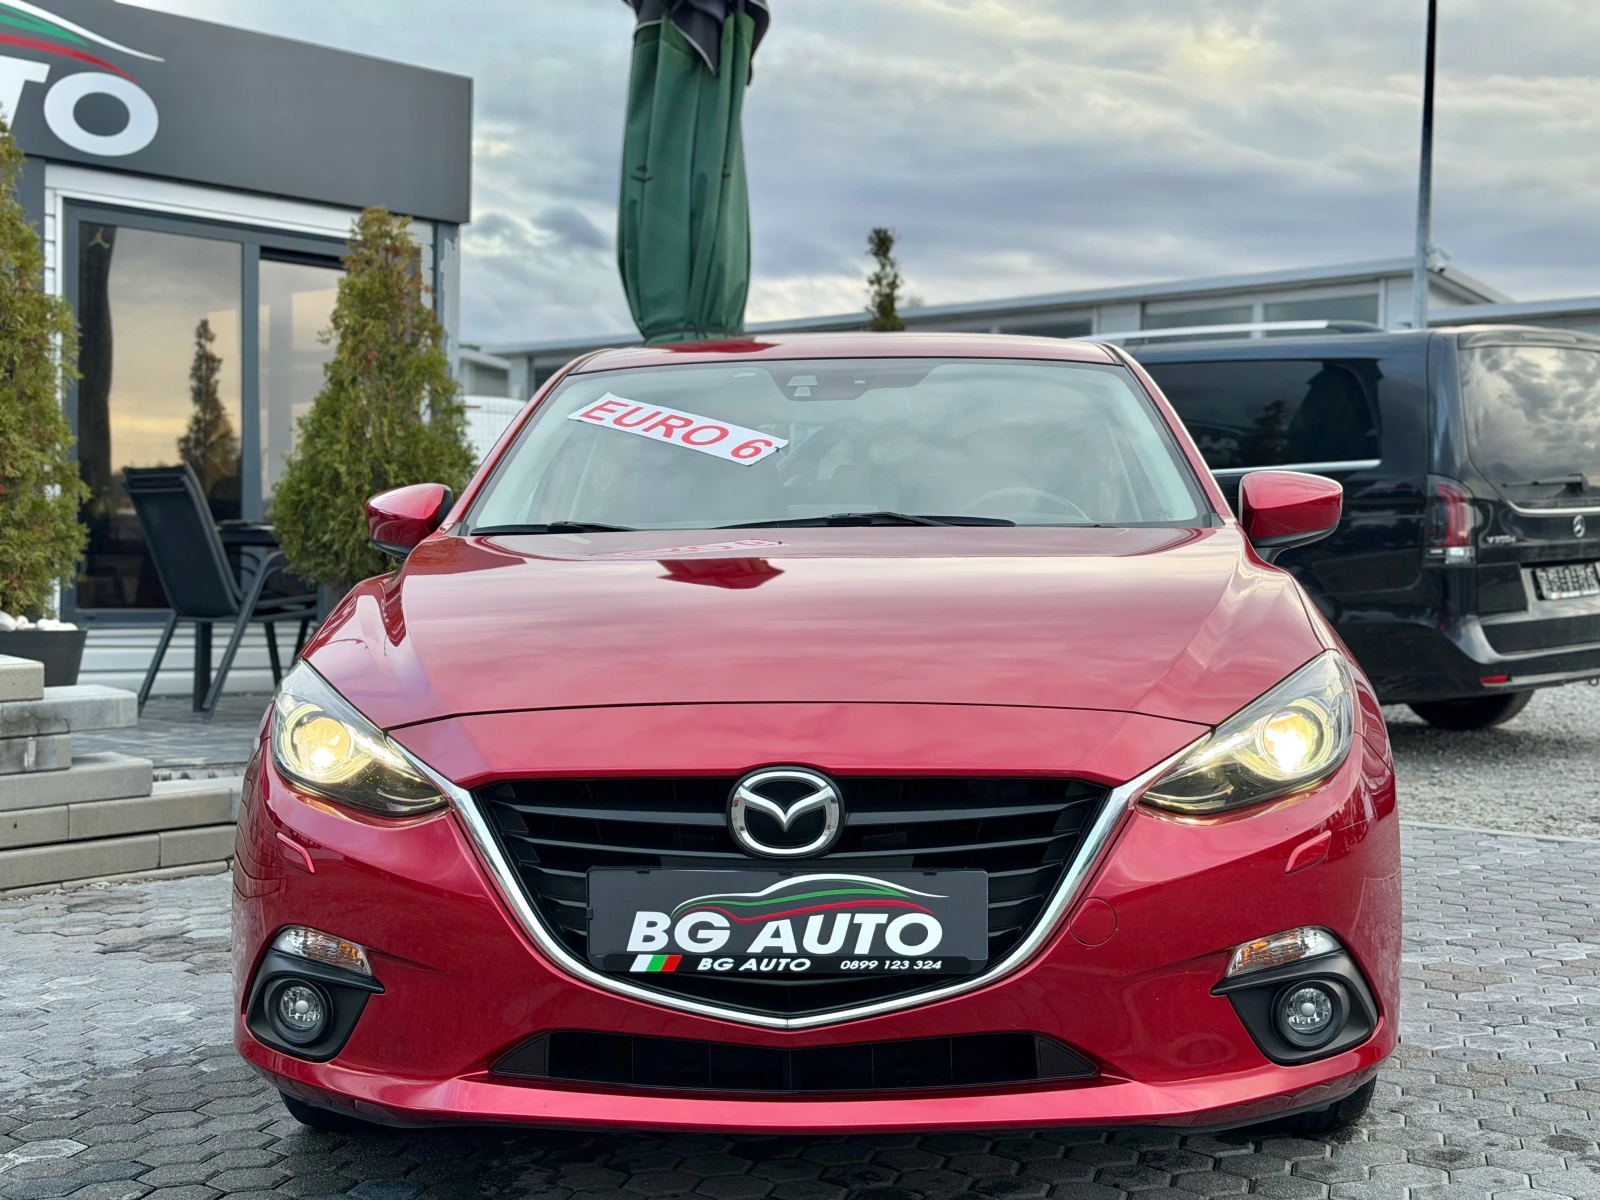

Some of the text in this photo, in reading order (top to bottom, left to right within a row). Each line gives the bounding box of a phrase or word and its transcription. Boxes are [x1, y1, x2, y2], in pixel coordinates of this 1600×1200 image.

[580, 400, 773, 459] EURO 6
[626, 911, 943, 956] BG AUTO
[697, 957, 811, 971] BG AUTO
[840, 960, 942, 970] 0899 123 324
